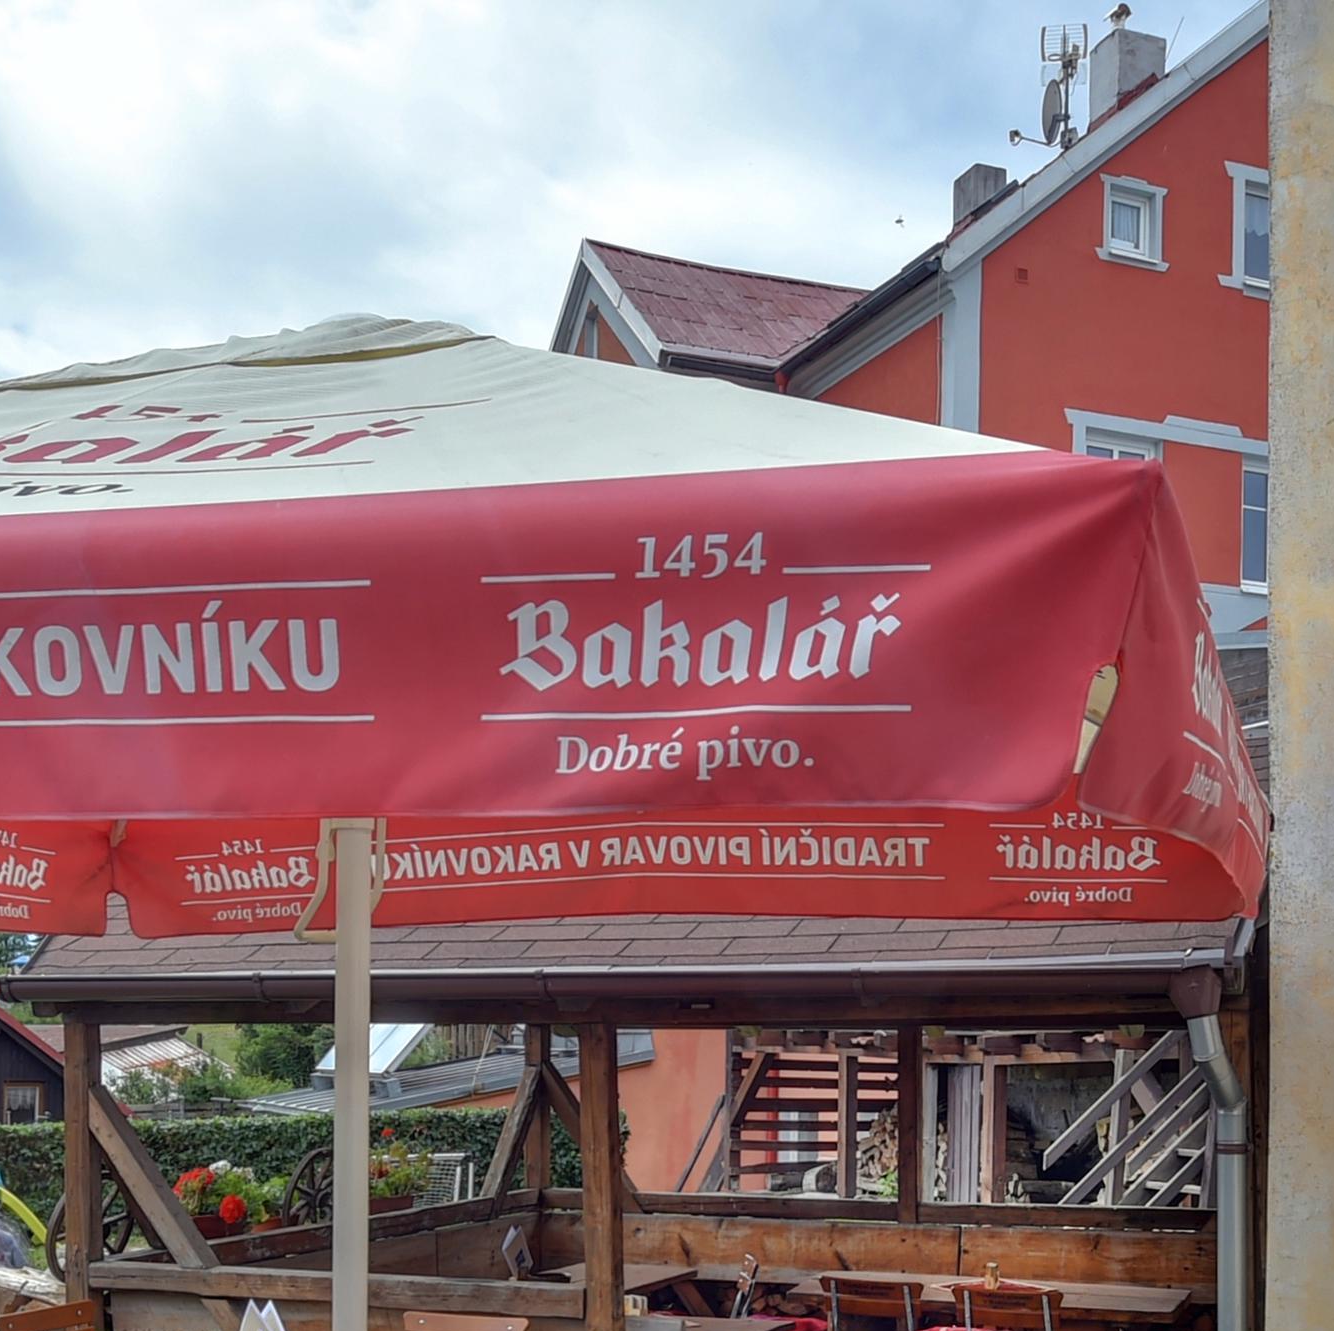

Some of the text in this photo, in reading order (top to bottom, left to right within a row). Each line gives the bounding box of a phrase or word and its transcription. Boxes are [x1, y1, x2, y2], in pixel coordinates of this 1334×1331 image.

[634, 531, 768, 580] 1454
[499, 591, 903, 693] Bakalář
[556, 726, 815, 781] Dobré pivo.
